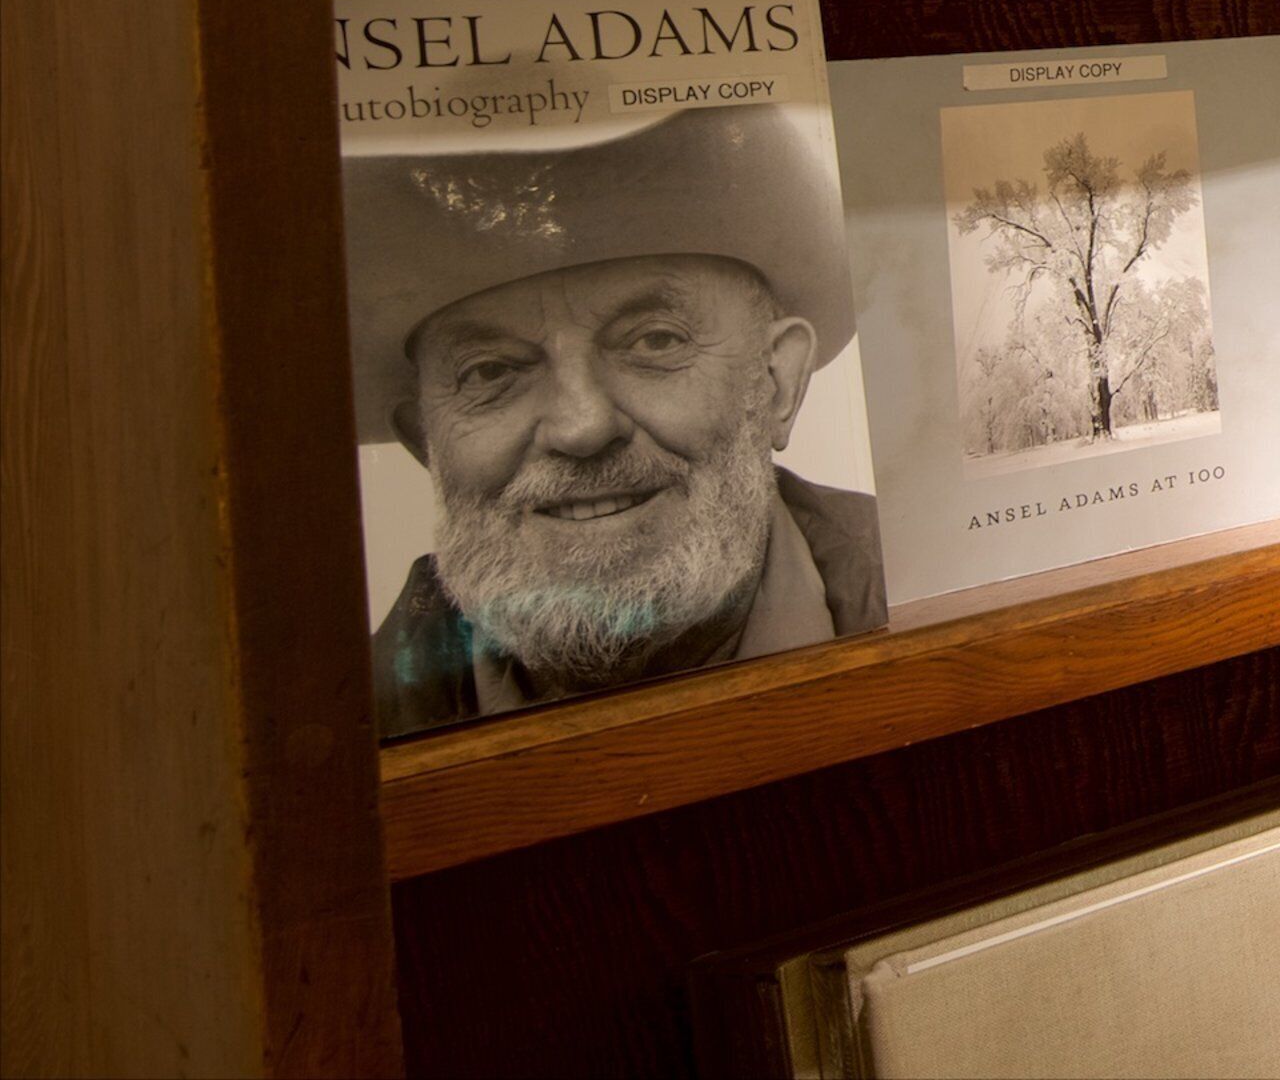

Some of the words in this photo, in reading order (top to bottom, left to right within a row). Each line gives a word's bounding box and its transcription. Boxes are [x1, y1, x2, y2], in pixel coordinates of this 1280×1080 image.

[535, 4, 800, 63] ADAMS
[1009, 64, 1075, 83] DISPLAY
[1079, 62, 1122, 79] COPY
[622, 85, 710, 106] DISPLAY
[718, 81, 775, 101] COPY
[967, 501, 1047, 531] ANSEL
[1058, 484, 1141, 511] ADAMS
[1151, 475, 1178, 492] AT
